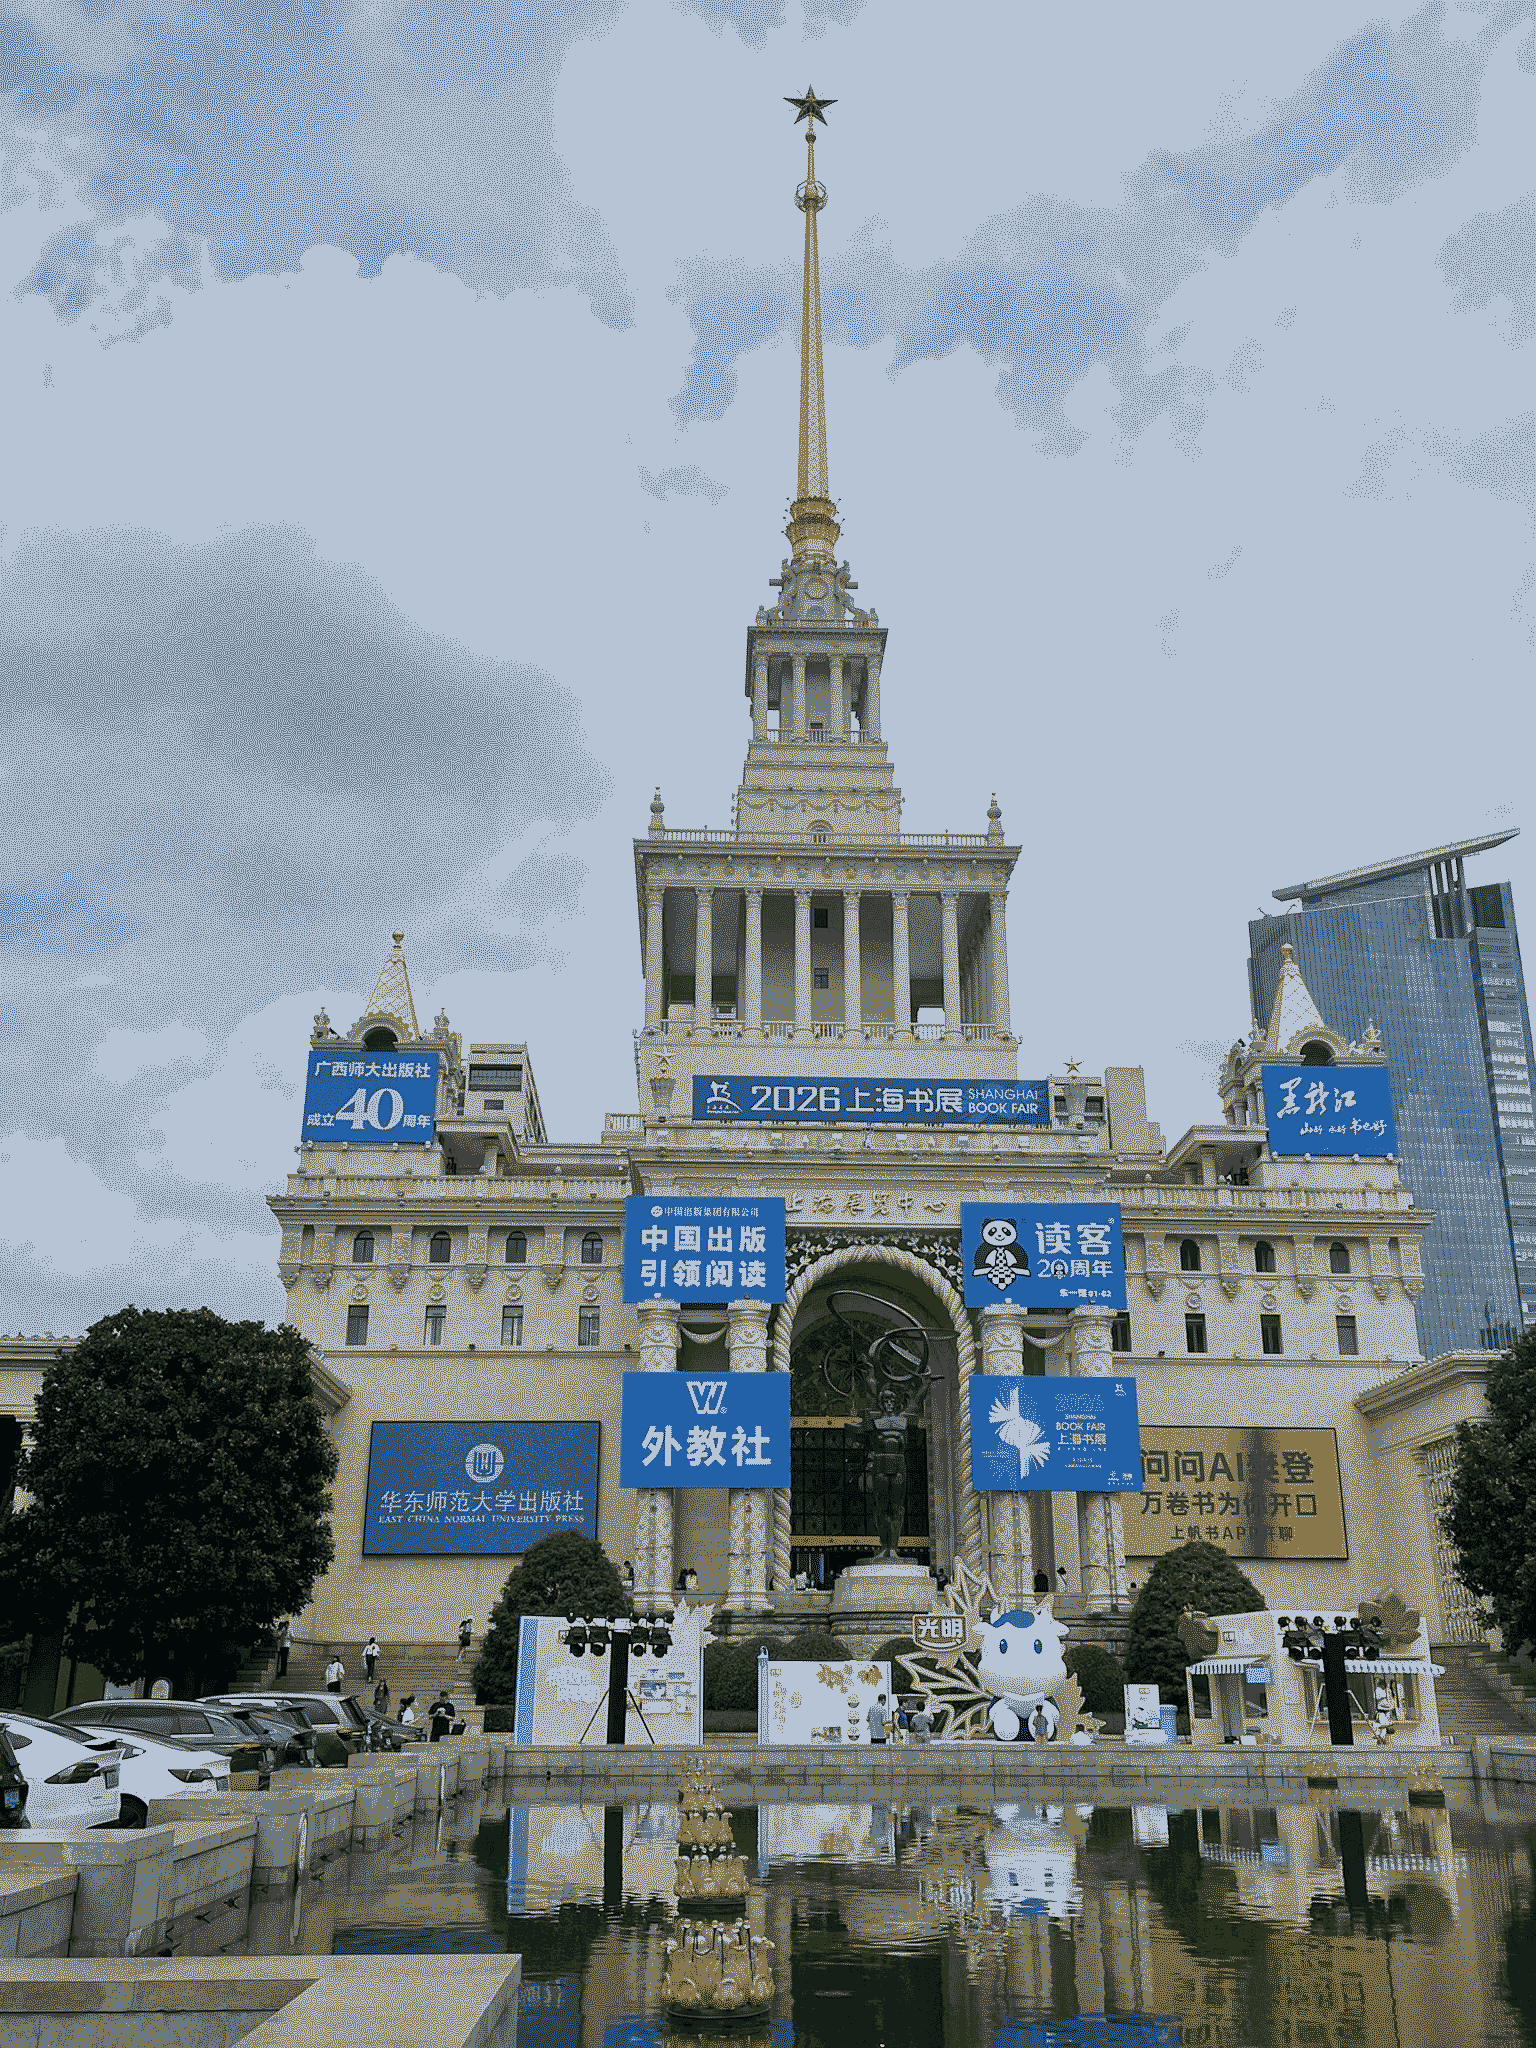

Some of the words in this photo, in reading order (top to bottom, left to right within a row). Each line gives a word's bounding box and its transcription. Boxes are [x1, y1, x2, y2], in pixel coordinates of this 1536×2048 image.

[315, 1061, 431, 1078] 广西师大出版社
[968, 1089, 1038, 1099] SHANGHAI
[968, 1103, 1007, 1114] BOOK
[1012, 1103, 1038, 1114] FAIR
[641, 1225, 767, 1252] 中国出版
[1035, 1222, 1112, 1255] 读客
[641, 1260, 767, 1287] 引领阅读
[1037, 1259, 1113, 1279] 20周年
[1054, 1394, 1105, 1412] 2026
[1055, 1421, 1084, 1431] BOOK
[1086, 1422, 1106, 1431] FAIR
[642, 1425, 772, 1467] 外教社
[380, 1490, 584, 1513] 华东师范大学出版社
[378, 1515, 403, 1524] EAST
[407, 1515, 440, 1524] CHINA
[444, 1515, 485, 1523] NORMAL
[492, 1515, 551, 1523] UNIVERSITY
[555, 1515, 585, 1523] PRESS
[918, 1618, 962, 1638] 光明
